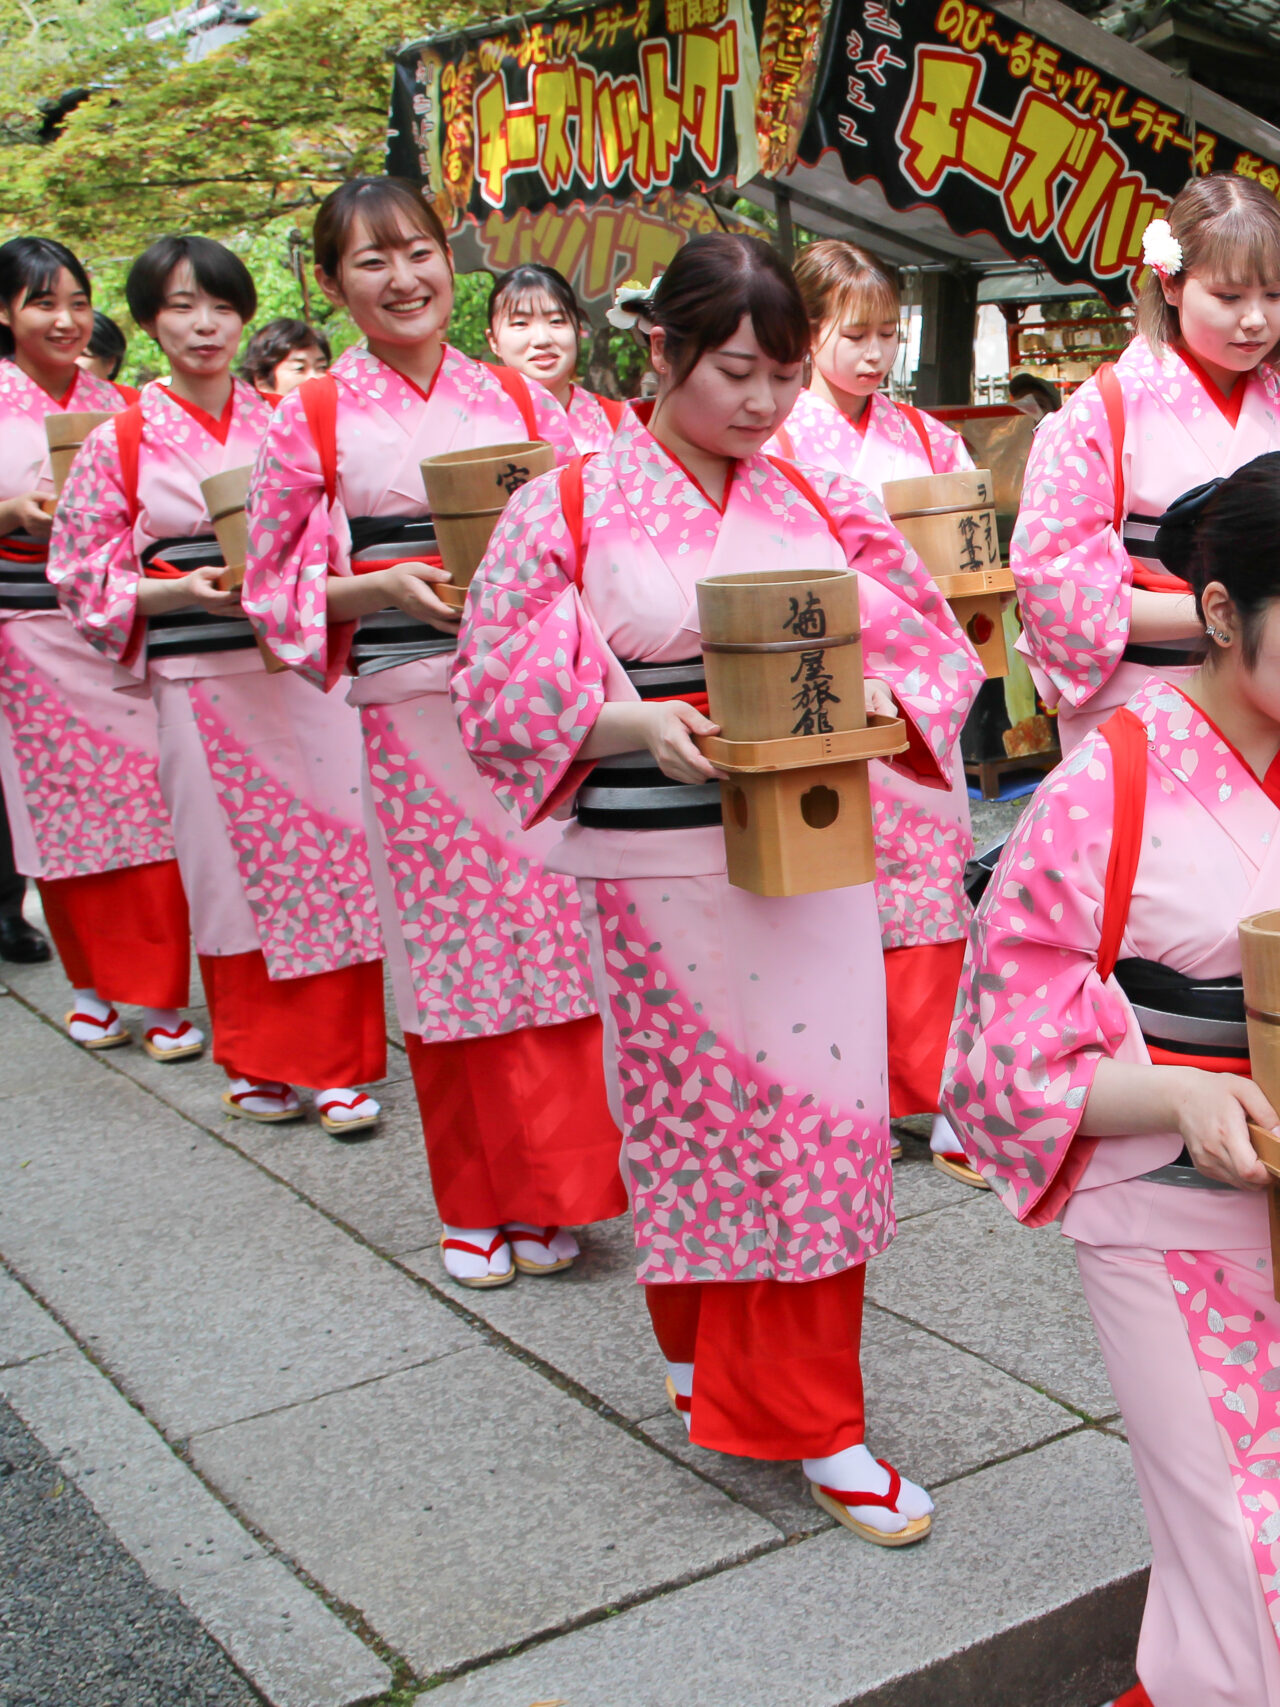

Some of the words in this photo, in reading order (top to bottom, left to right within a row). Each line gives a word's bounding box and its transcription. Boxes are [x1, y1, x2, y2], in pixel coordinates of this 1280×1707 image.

[472, 19, 740, 208] チーズハットグ
